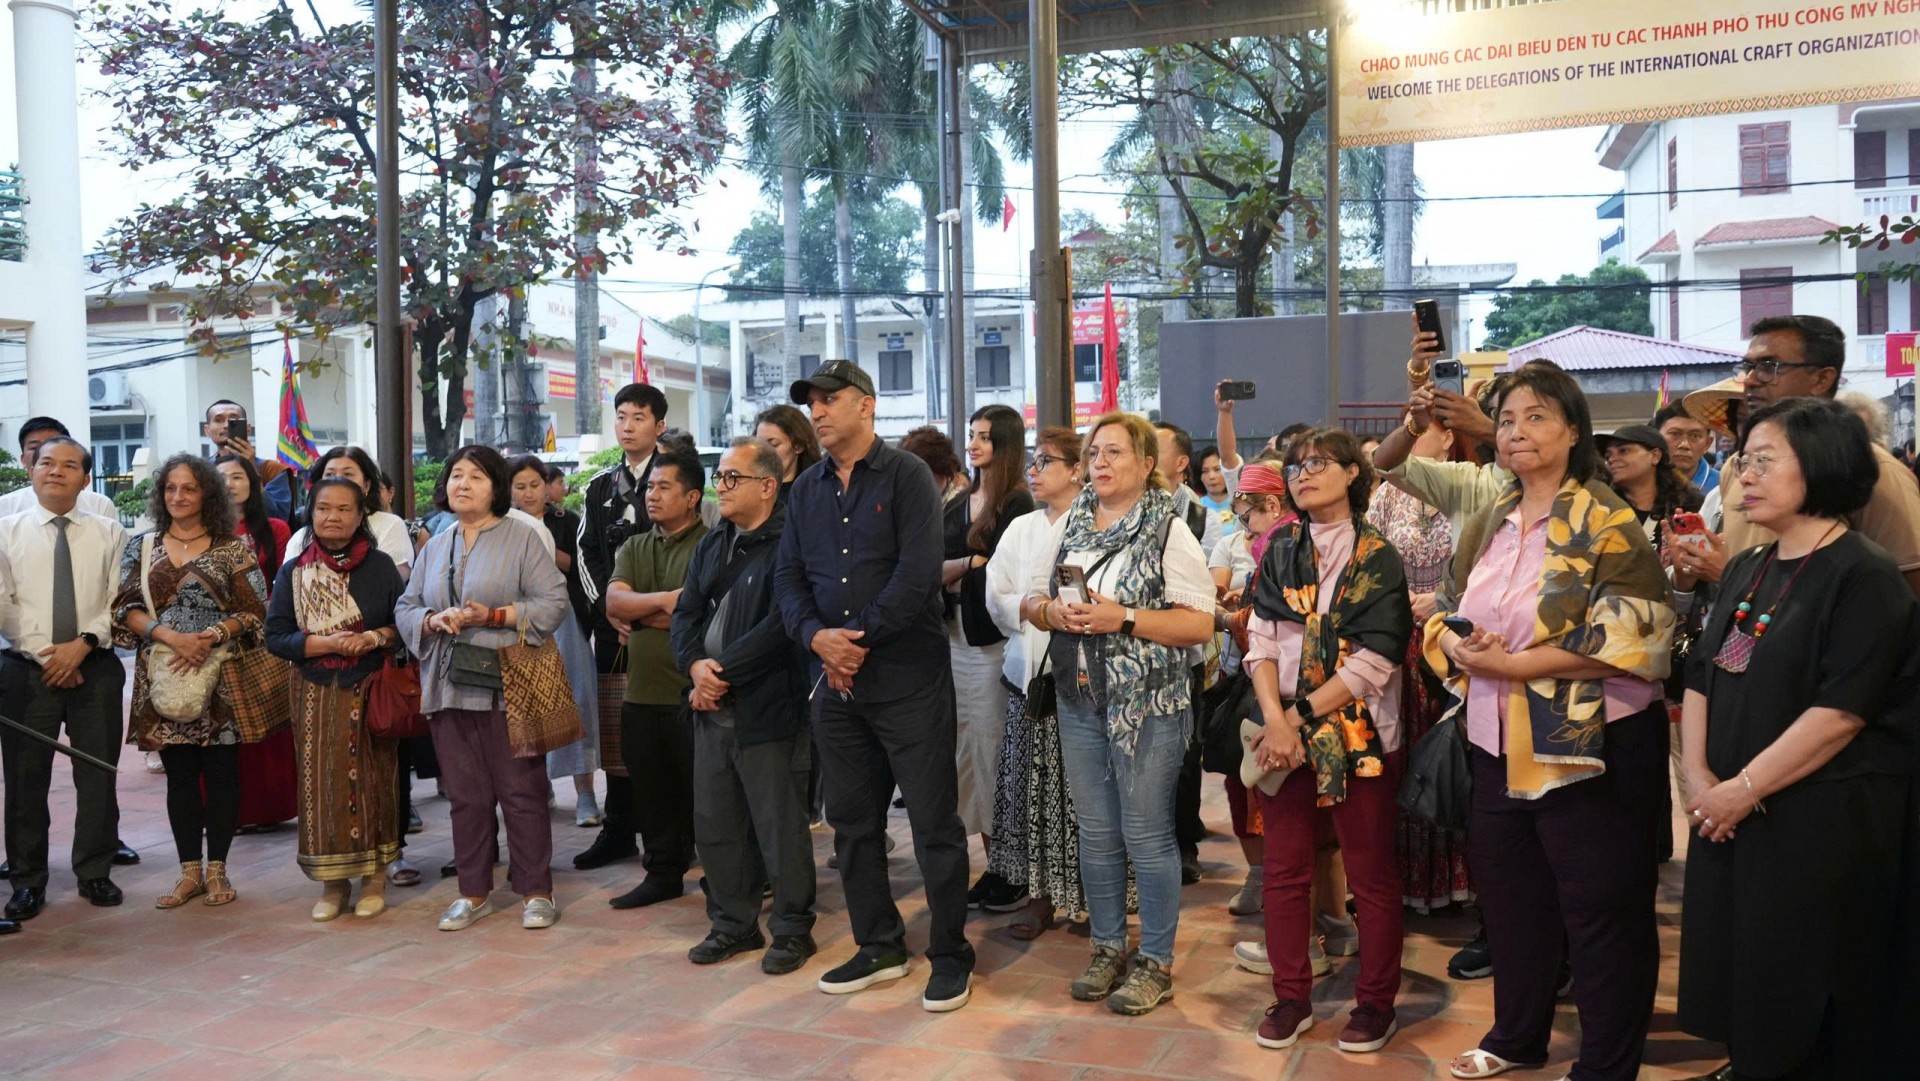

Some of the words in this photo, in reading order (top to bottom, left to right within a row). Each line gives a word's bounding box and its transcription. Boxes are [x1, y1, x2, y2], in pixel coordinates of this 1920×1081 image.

[1367, 81, 1432, 101] WELCOME
[1436, 77, 1462, 94] THE
[1466, 67, 1561, 91] DELEGATIONS
[1564, 65, 1584, 81] OF
[1588, 61, 1615, 78] THE
[1620, 48, 1739, 75] INTERNATIONAL
[1743, 42, 1793, 62] CRAFT
